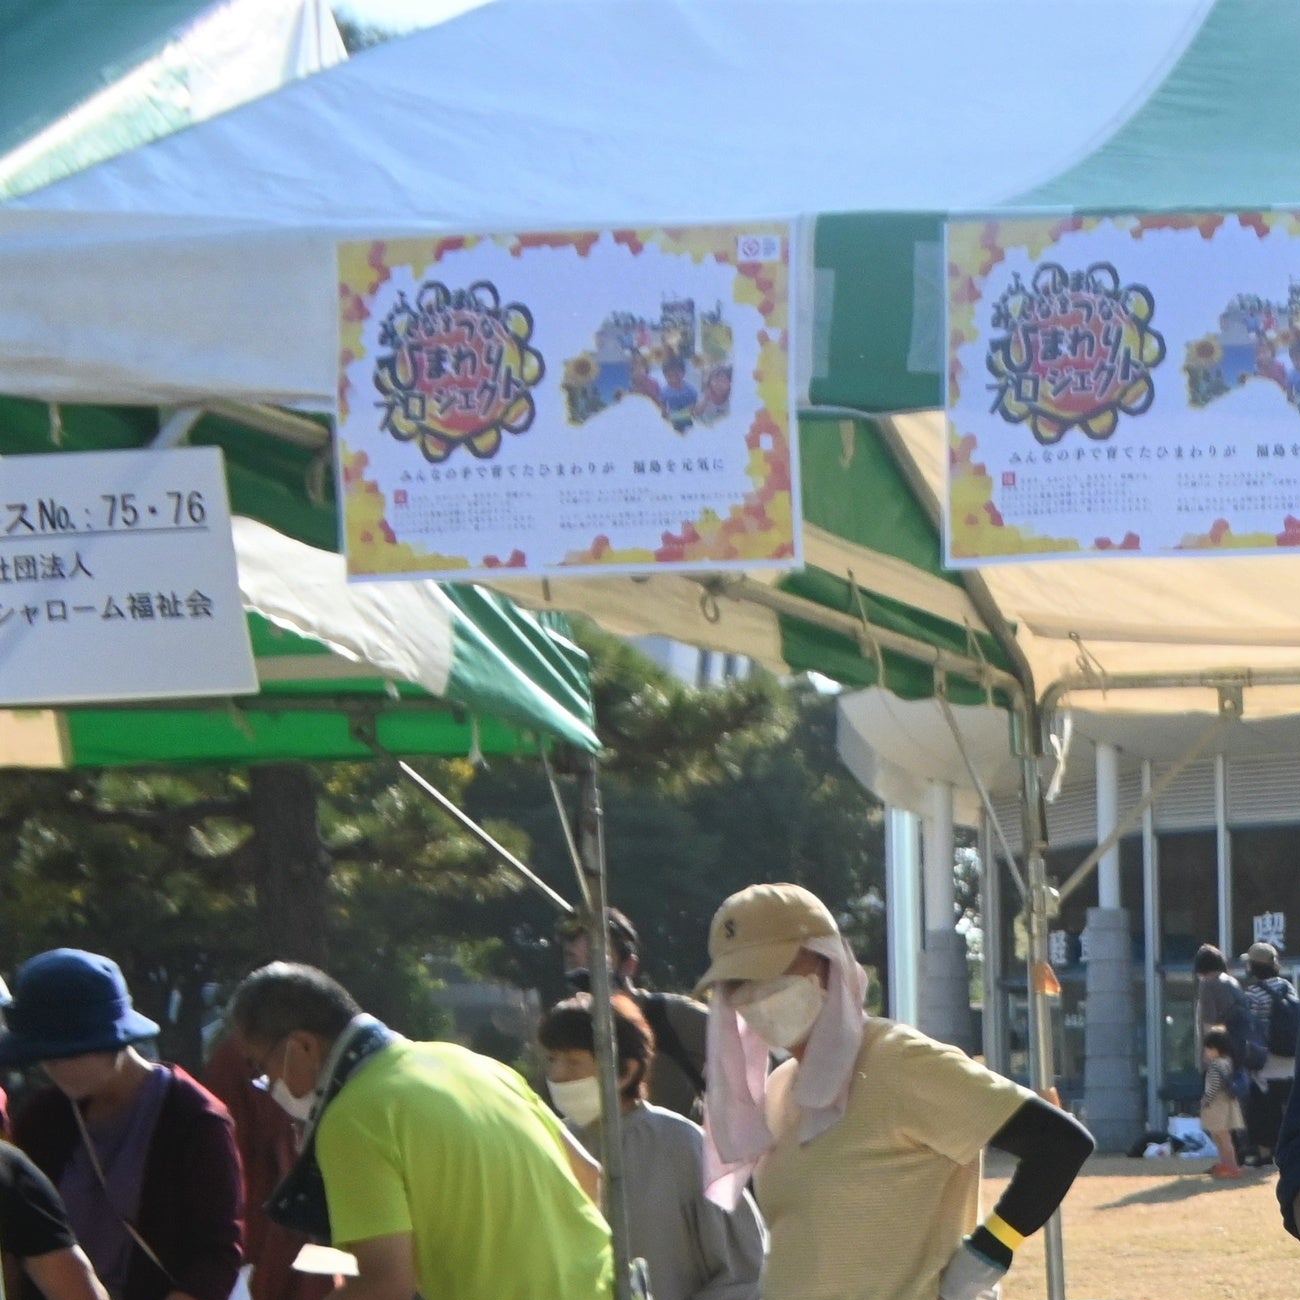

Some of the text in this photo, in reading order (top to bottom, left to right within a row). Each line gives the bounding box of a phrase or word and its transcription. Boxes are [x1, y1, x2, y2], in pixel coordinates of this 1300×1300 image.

[1008, 444, 1237, 465] みんなの手で育てたひまわりが
[633, 458, 724, 476] 福島を元気に
